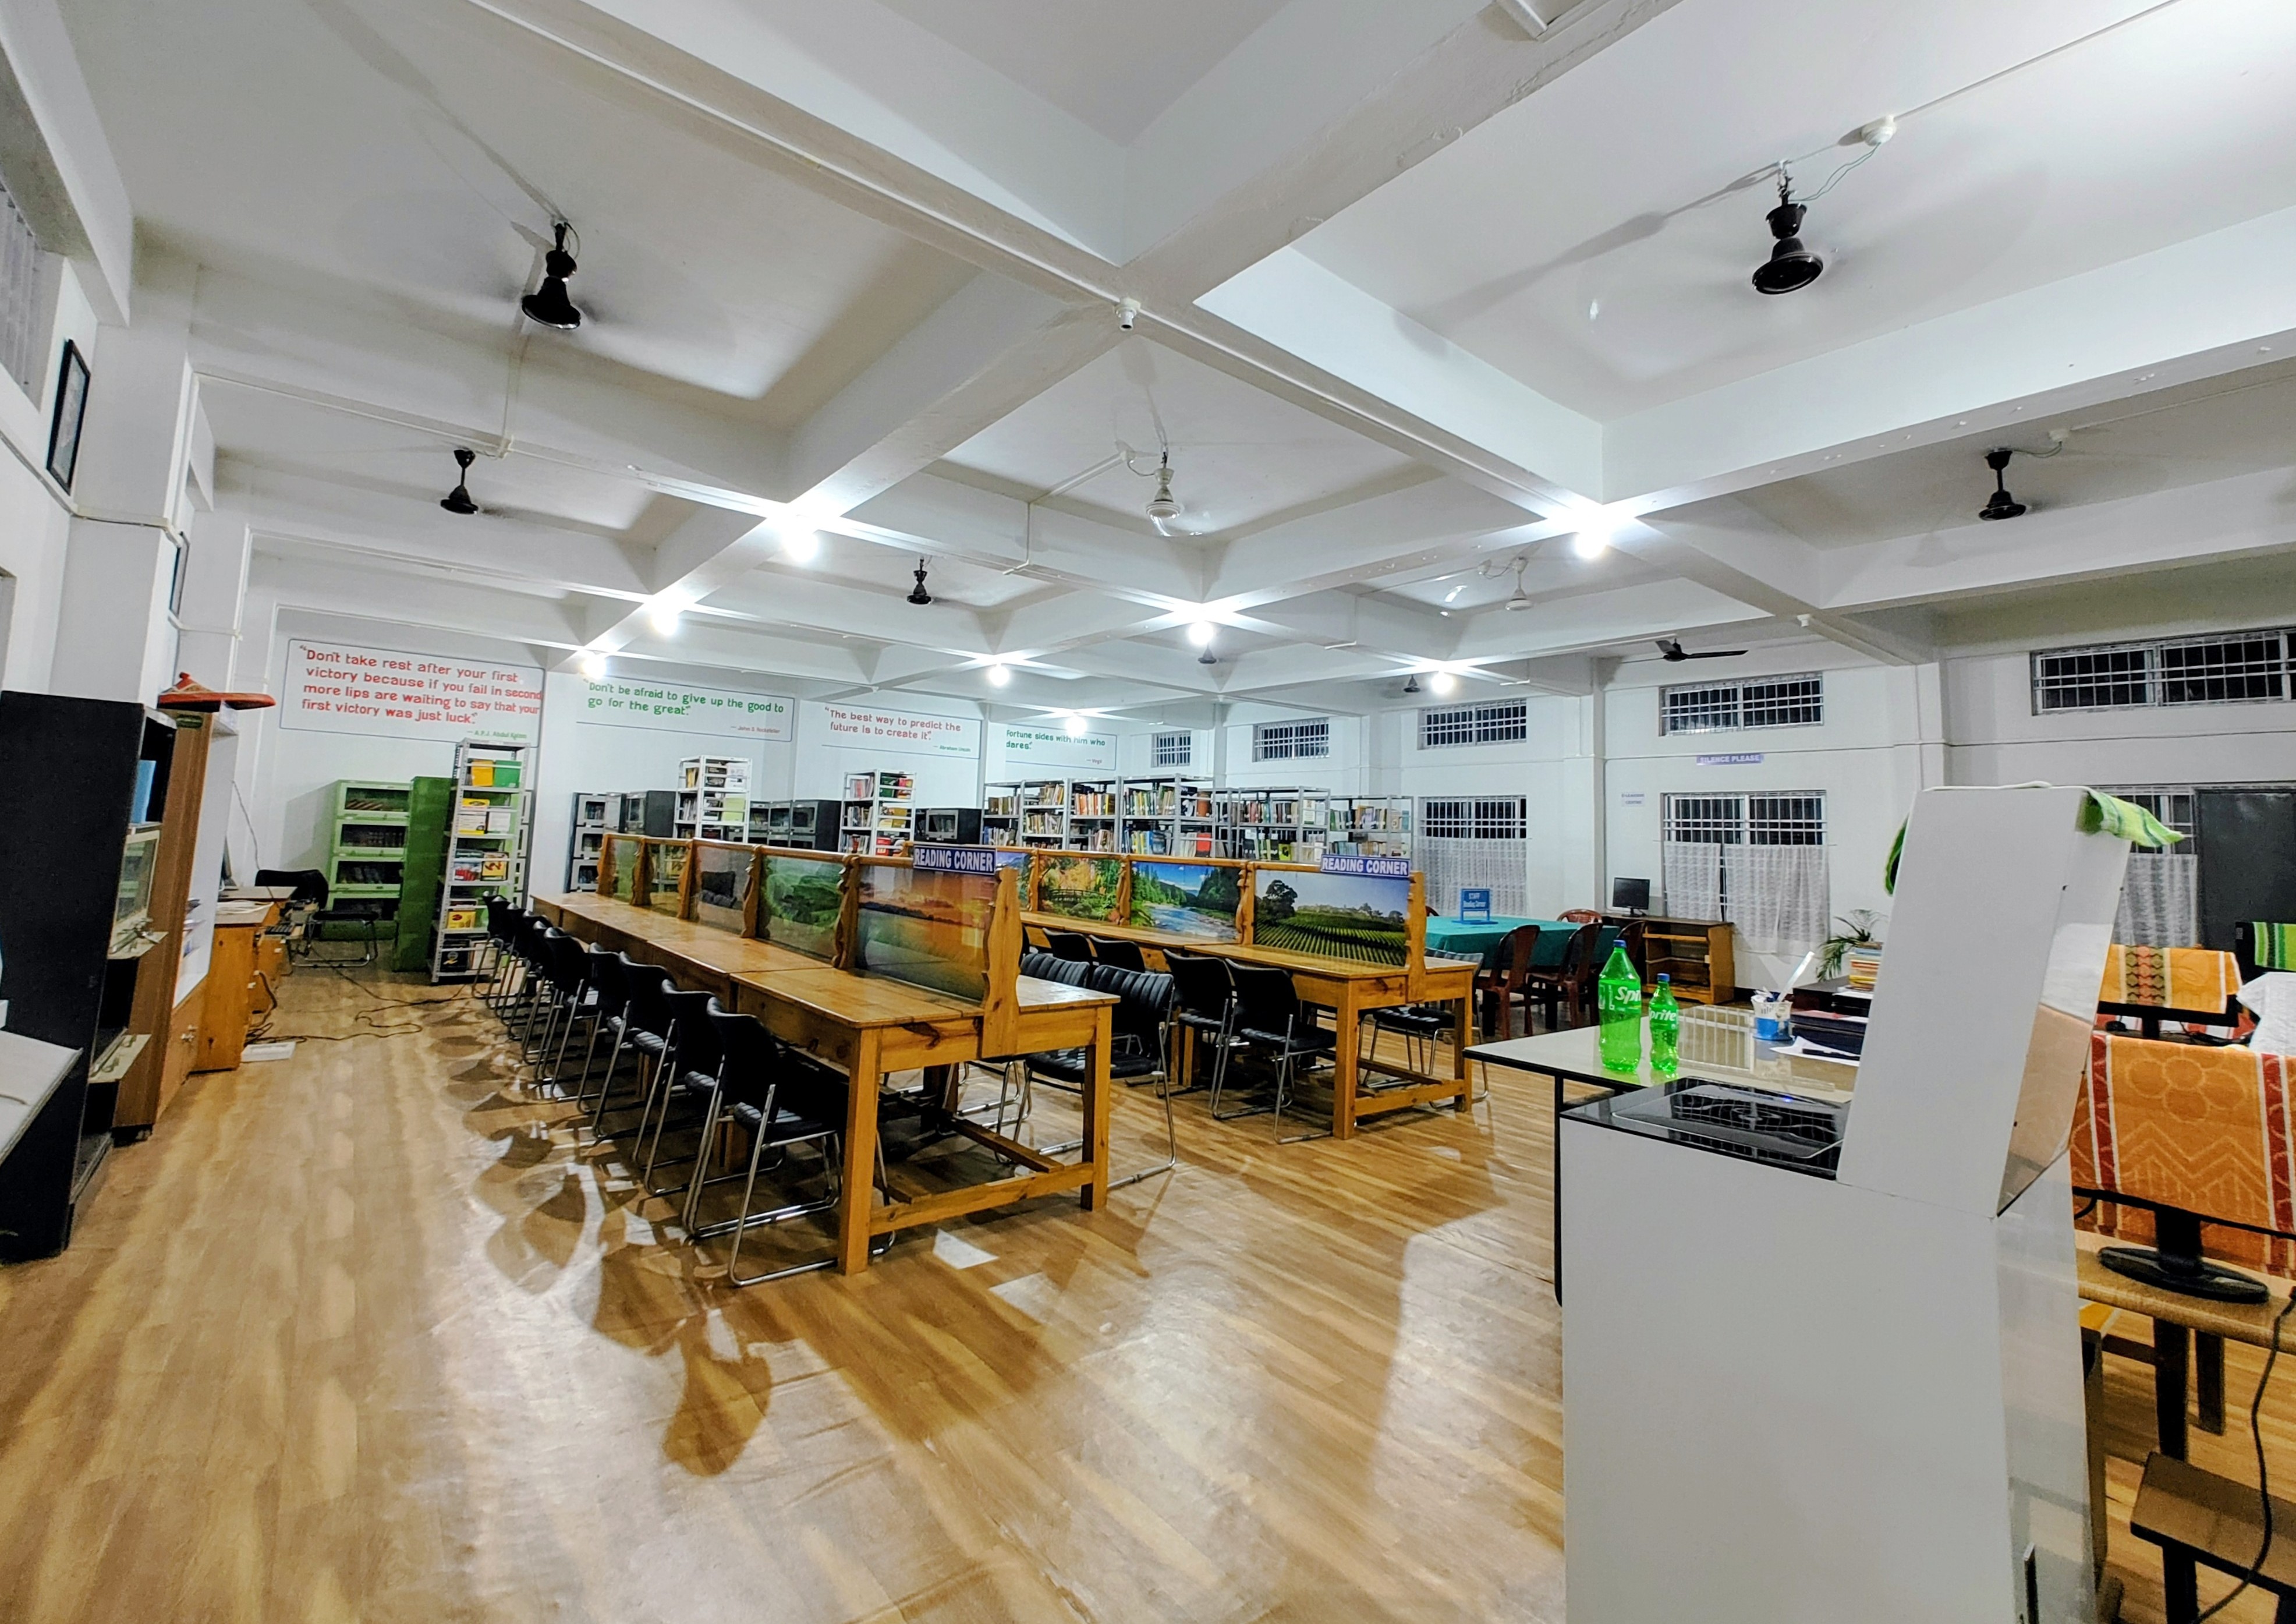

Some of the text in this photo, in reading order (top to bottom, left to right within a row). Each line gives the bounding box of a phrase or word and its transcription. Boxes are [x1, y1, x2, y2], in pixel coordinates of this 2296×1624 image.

[346, 653, 377, 667] take
[382, 659, 413, 671] rest
[417, 663, 451, 674] after
[457, 668, 486, 679] your
[492, 670, 518, 682] first
[306, 667, 543, 700] victory because if you fail in second
[303, 685, 540, 714] more lips are waiting to say that your
[588, 698, 603, 708] go
[609, 698, 624, 707] for
[629, 700, 649, 711] the
[618, 685, 630, 695] be
[634, 688, 663, 698] afraid
[667, 691, 678, 700] to
[682, 694, 706, 705] give
[710, 698, 723, 707] up
[728, 698, 743, 708] the
[747, 702, 771, 713] good
[774, 703, 784, 713] to
[302, 699, 331, 711] first
[335, 702, 380, 716] victory
[385, 708, 413, 718] was
[415, 709, 442, 721] just
[830, 721, 858, 733] future
[862, 725, 871, 734] is
[874, 726, 884, 735] to
[887, 728, 918, 738] create
[851, 712, 872, 722] best
[876, 716, 894, 726] way
[898, 717, 907, 726] to
[910, 720, 942, 730] predict
[945, 722, 961, 731] the
[1007, 730, 1032, 739] Fortune
[1034, 733, 1054, 741] sides
[1055, 735, 1071, 743] with
[1073, 736, 1087, 745] him
[914, 848, 994, 872] READING CORNER
[1322, 857, 1408, 875] READING CORNER
[1648, 1007, 1677, 1021] prite
